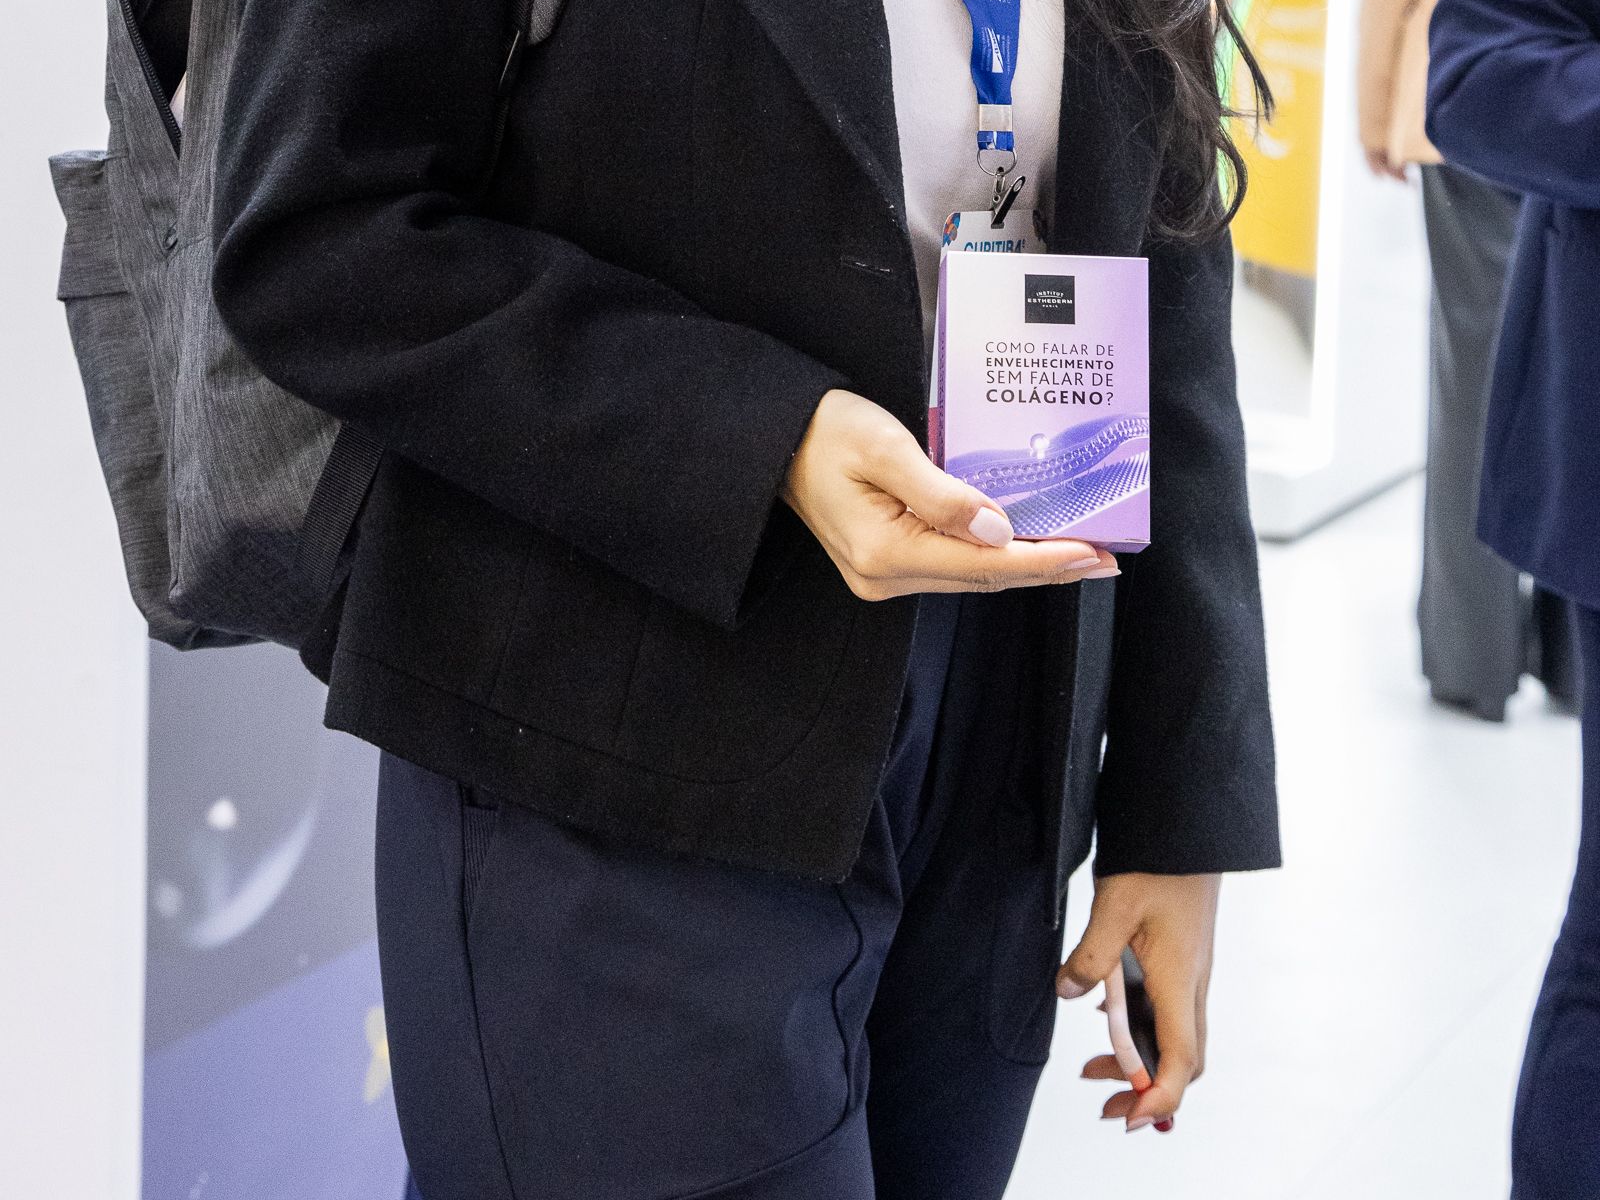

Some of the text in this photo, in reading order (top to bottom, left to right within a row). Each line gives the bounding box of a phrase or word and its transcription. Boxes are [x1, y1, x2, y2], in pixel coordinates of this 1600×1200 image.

[985, 342, 1114, 356] COMO FALAR DE
[986, 357, 1114, 370] ENVELHECIMENTO
[986, 370, 1114, 387] SEM FALAR DE
[986, 387, 1114, 405] COLÁGENO?
